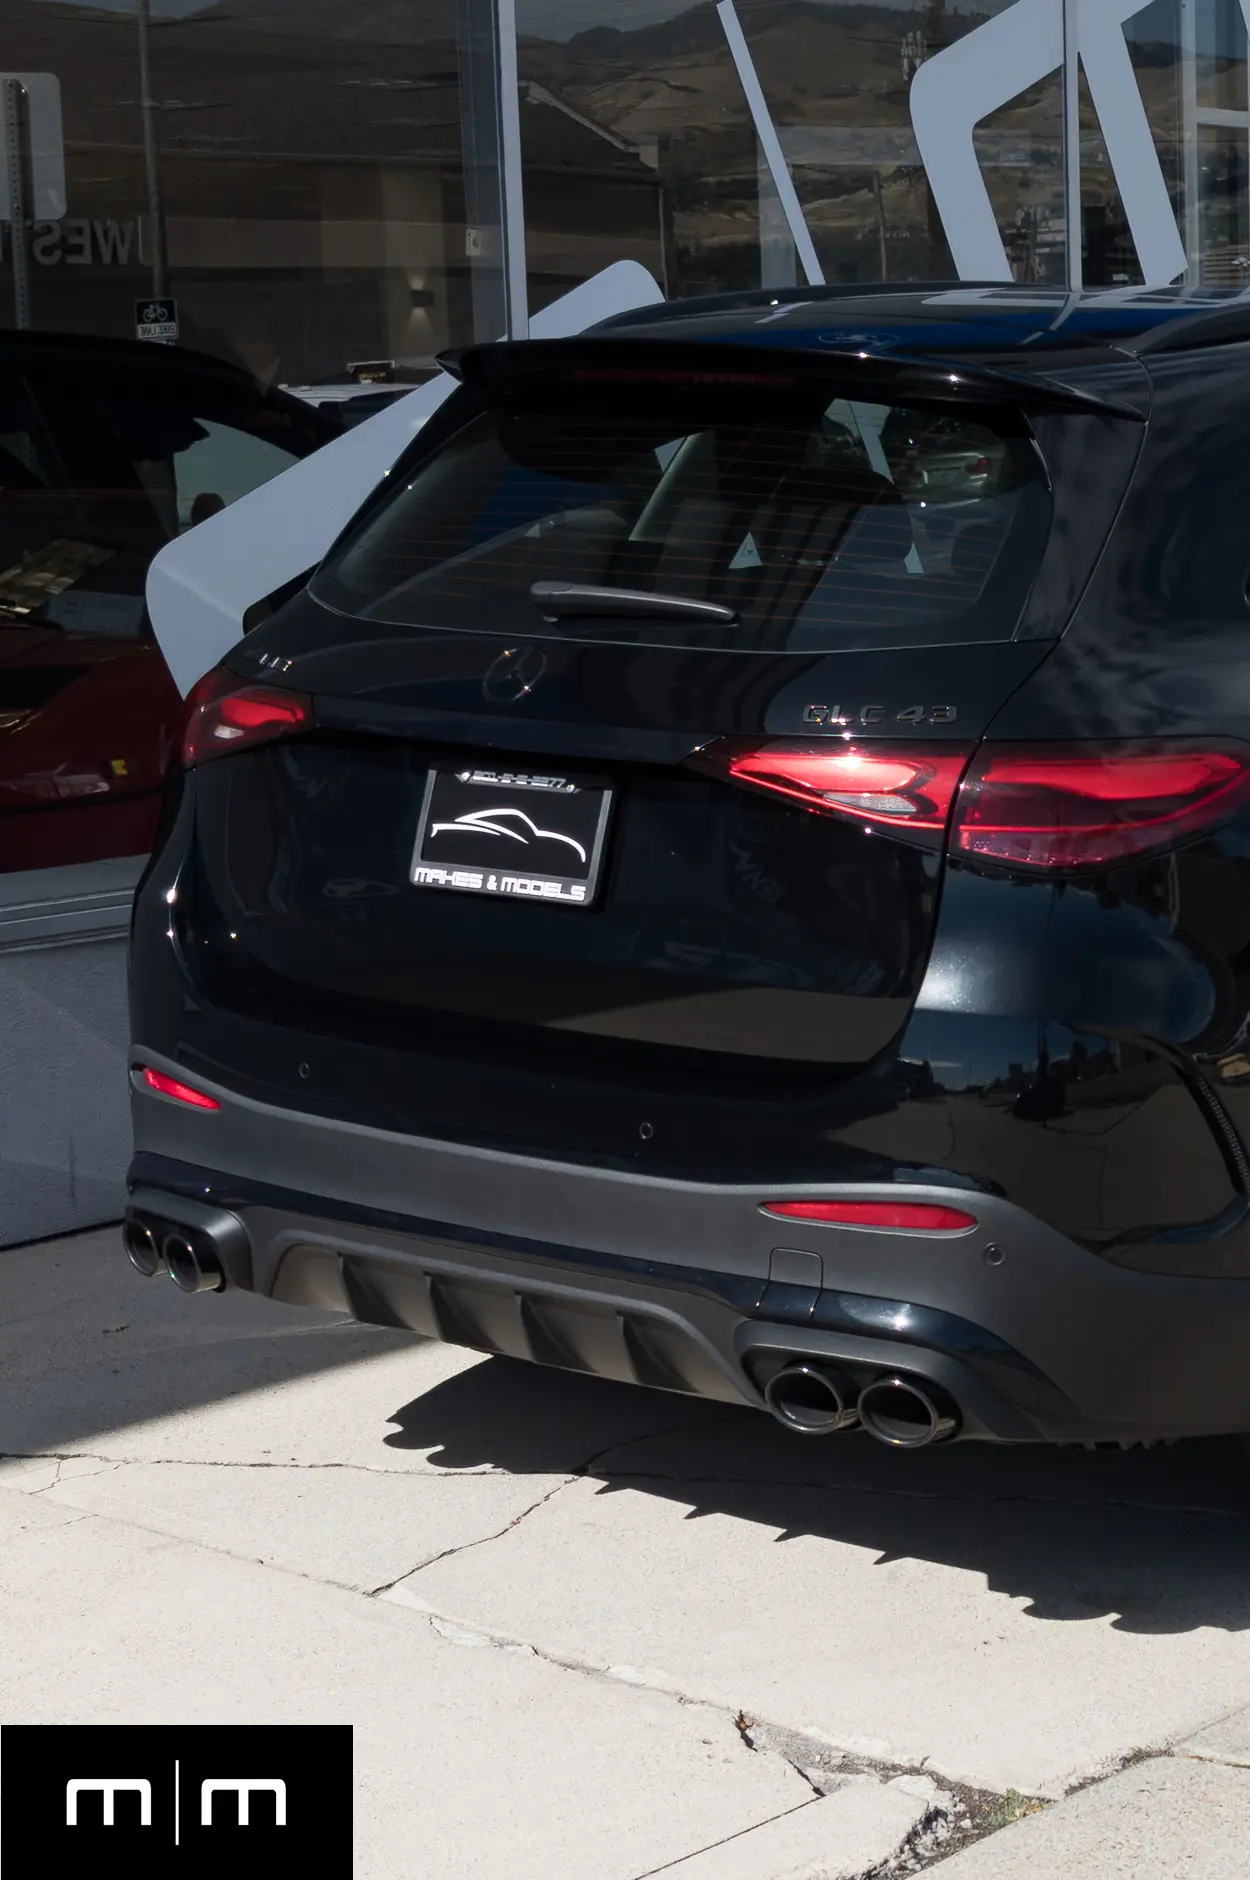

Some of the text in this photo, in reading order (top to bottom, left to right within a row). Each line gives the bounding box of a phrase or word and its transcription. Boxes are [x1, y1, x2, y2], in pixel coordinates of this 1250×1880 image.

[802, 704, 958, 726] GLC 43
[413, 867, 586, 901] MAKES & MODELS
